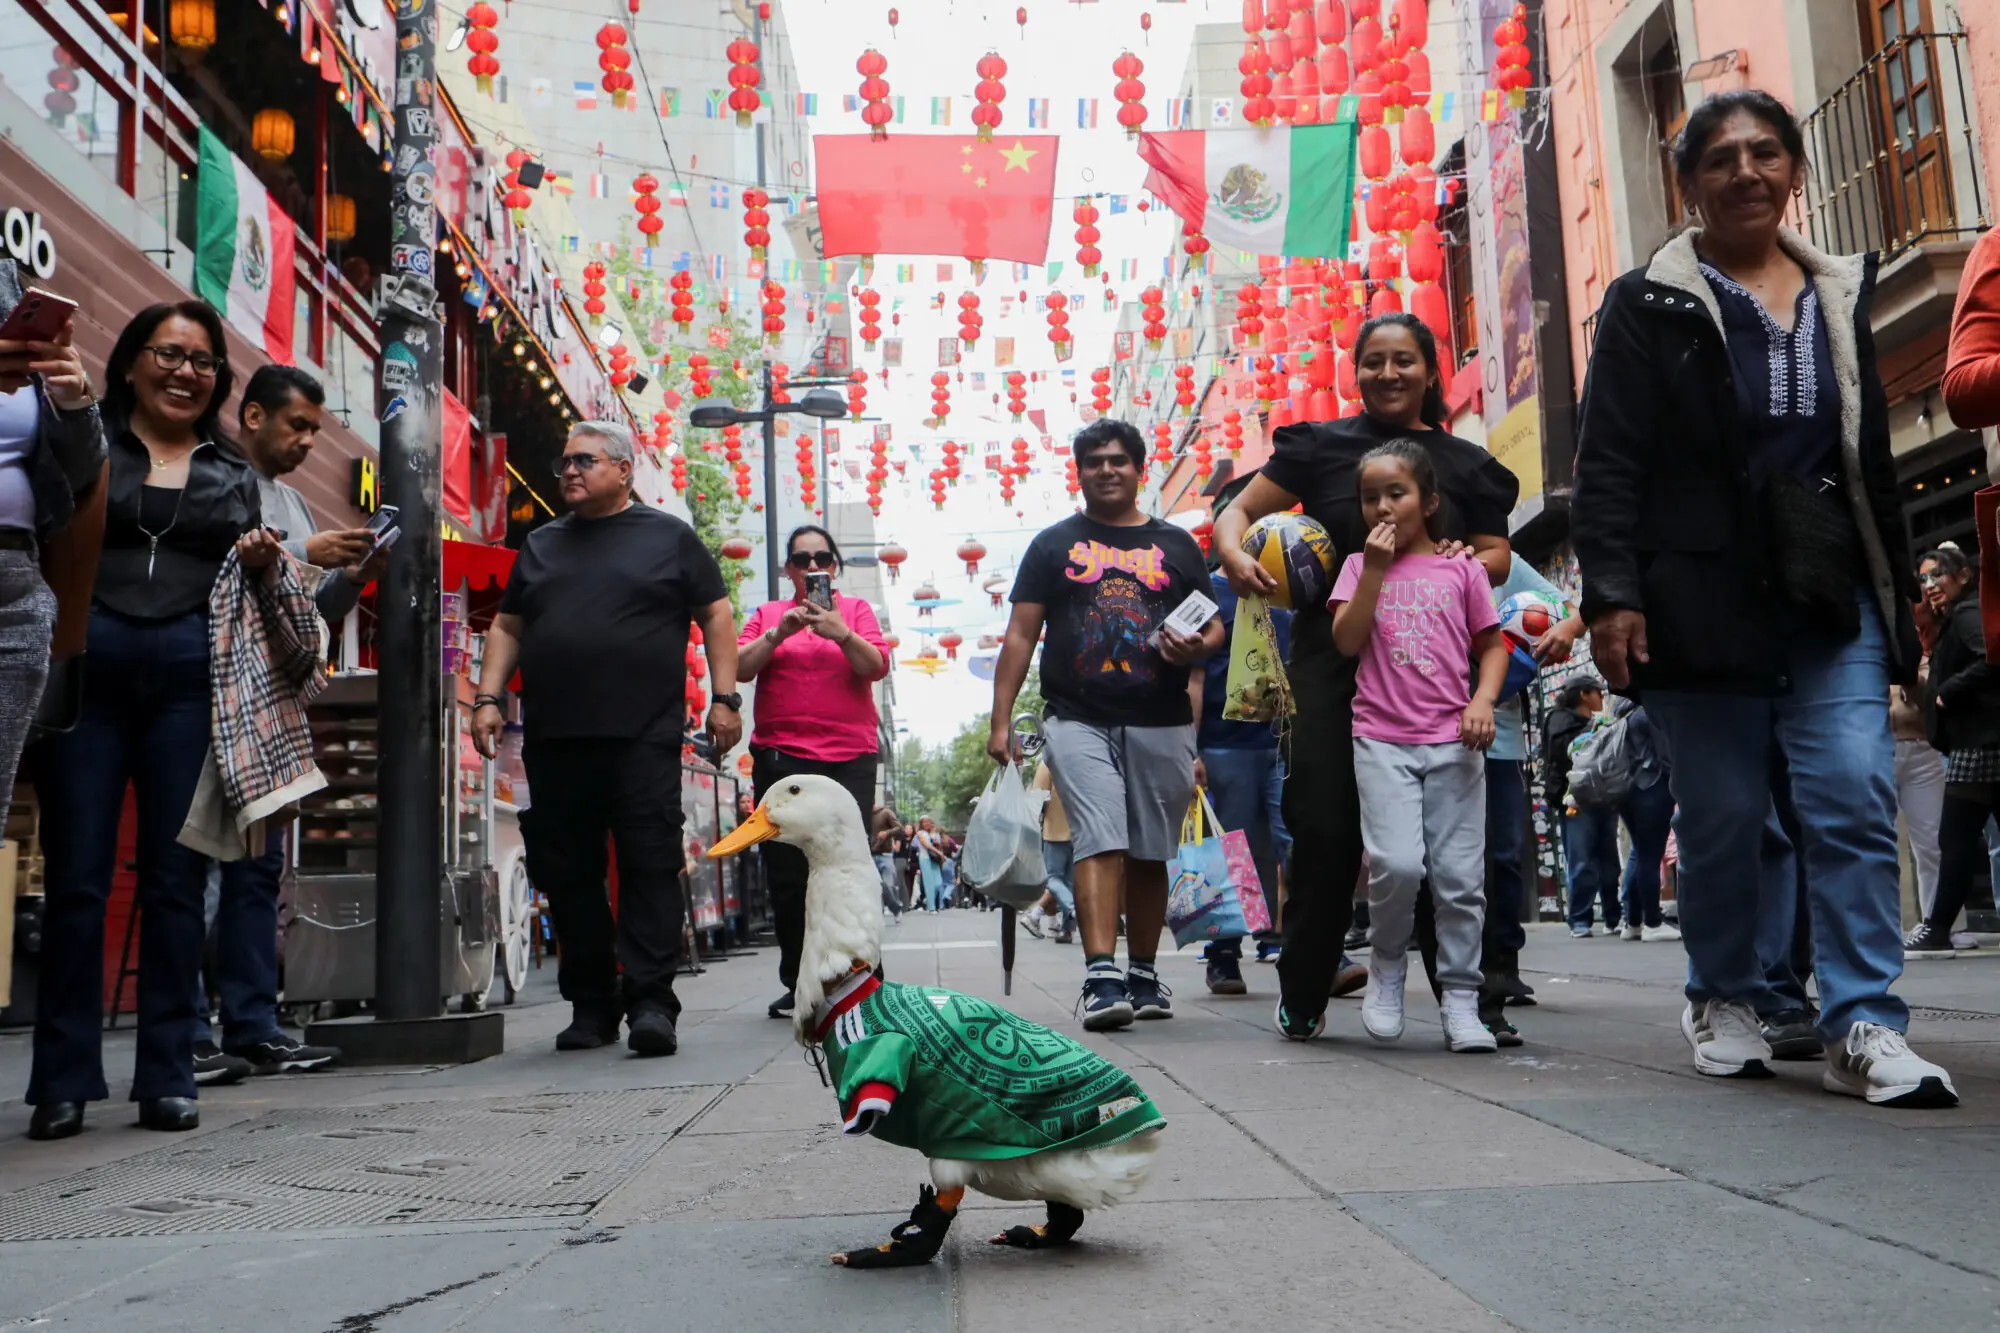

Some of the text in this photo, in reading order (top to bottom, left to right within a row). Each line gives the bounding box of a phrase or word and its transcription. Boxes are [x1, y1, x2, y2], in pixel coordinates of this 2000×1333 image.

[0, 206, 56, 280] ab
[1474, 182, 1499, 394] CHINO
[1383, 580, 1447, 611] JUST
[1395, 610, 1433, 637] DO
